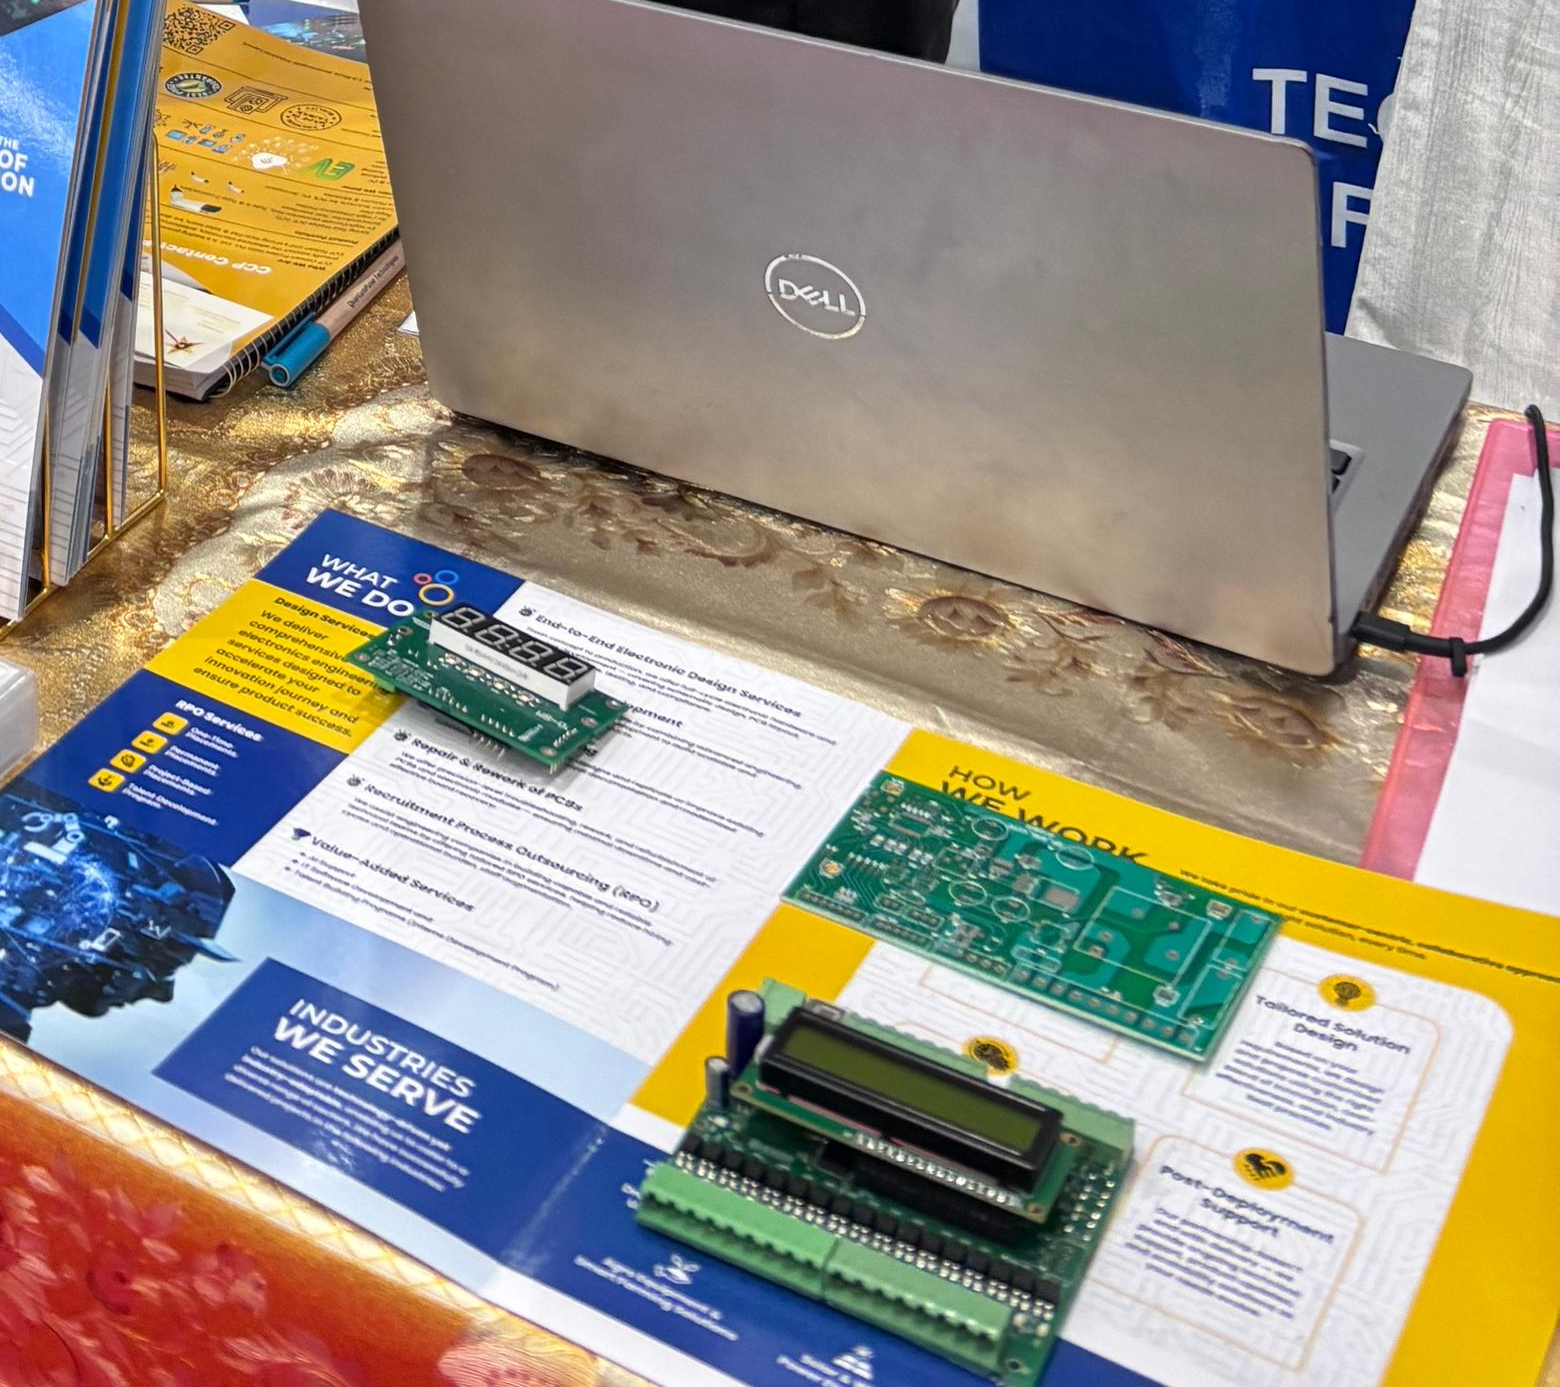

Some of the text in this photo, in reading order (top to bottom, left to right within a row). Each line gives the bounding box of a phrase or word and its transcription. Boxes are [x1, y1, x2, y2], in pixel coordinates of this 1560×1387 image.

[232, 261, 272, 275] CCP
[779, 279, 856, 316] DELL
[306, 568, 413, 617] WE DO
[322, 554, 399, 588] WHAT
[261, 610, 329, 641] We deliver
[274, 597, 321, 619] Design
[227, 638, 361, 697] services designed to
[238, 629, 311, 661] electronics
[535, 614, 802, 718] End-to-End Electronic Design Services
[204, 656, 360, 725] innovation journey and
[216, 647, 320, 694] accelerate your
[174, 699, 264, 742] RPO Services
[193, 667, 353, 738] ensure product success.
[410, 738, 584, 812] Repair & Rework of PCBs
[949, 765, 1031, 801] HOW
[364, 783, 454, 829] Recruitment
[455, 819, 513, 851] Process
[516, 845, 610, 893] Outsourcing
[311, 835, 476, 912] Value-Added Services
[289, 999, 476, 1098] INDUSTRIES
[1256, 994, 1411, 1055] Tailored Solution
[1293, 1023, 1359, 1052] Design
[274, 1016, 346, 1064] WE
[342, 1054, 482, 1134] SERVE
[1160, 1165, 1335, 1244] Post-Deployment
[1201, 1198, 1279, 1237] Support
